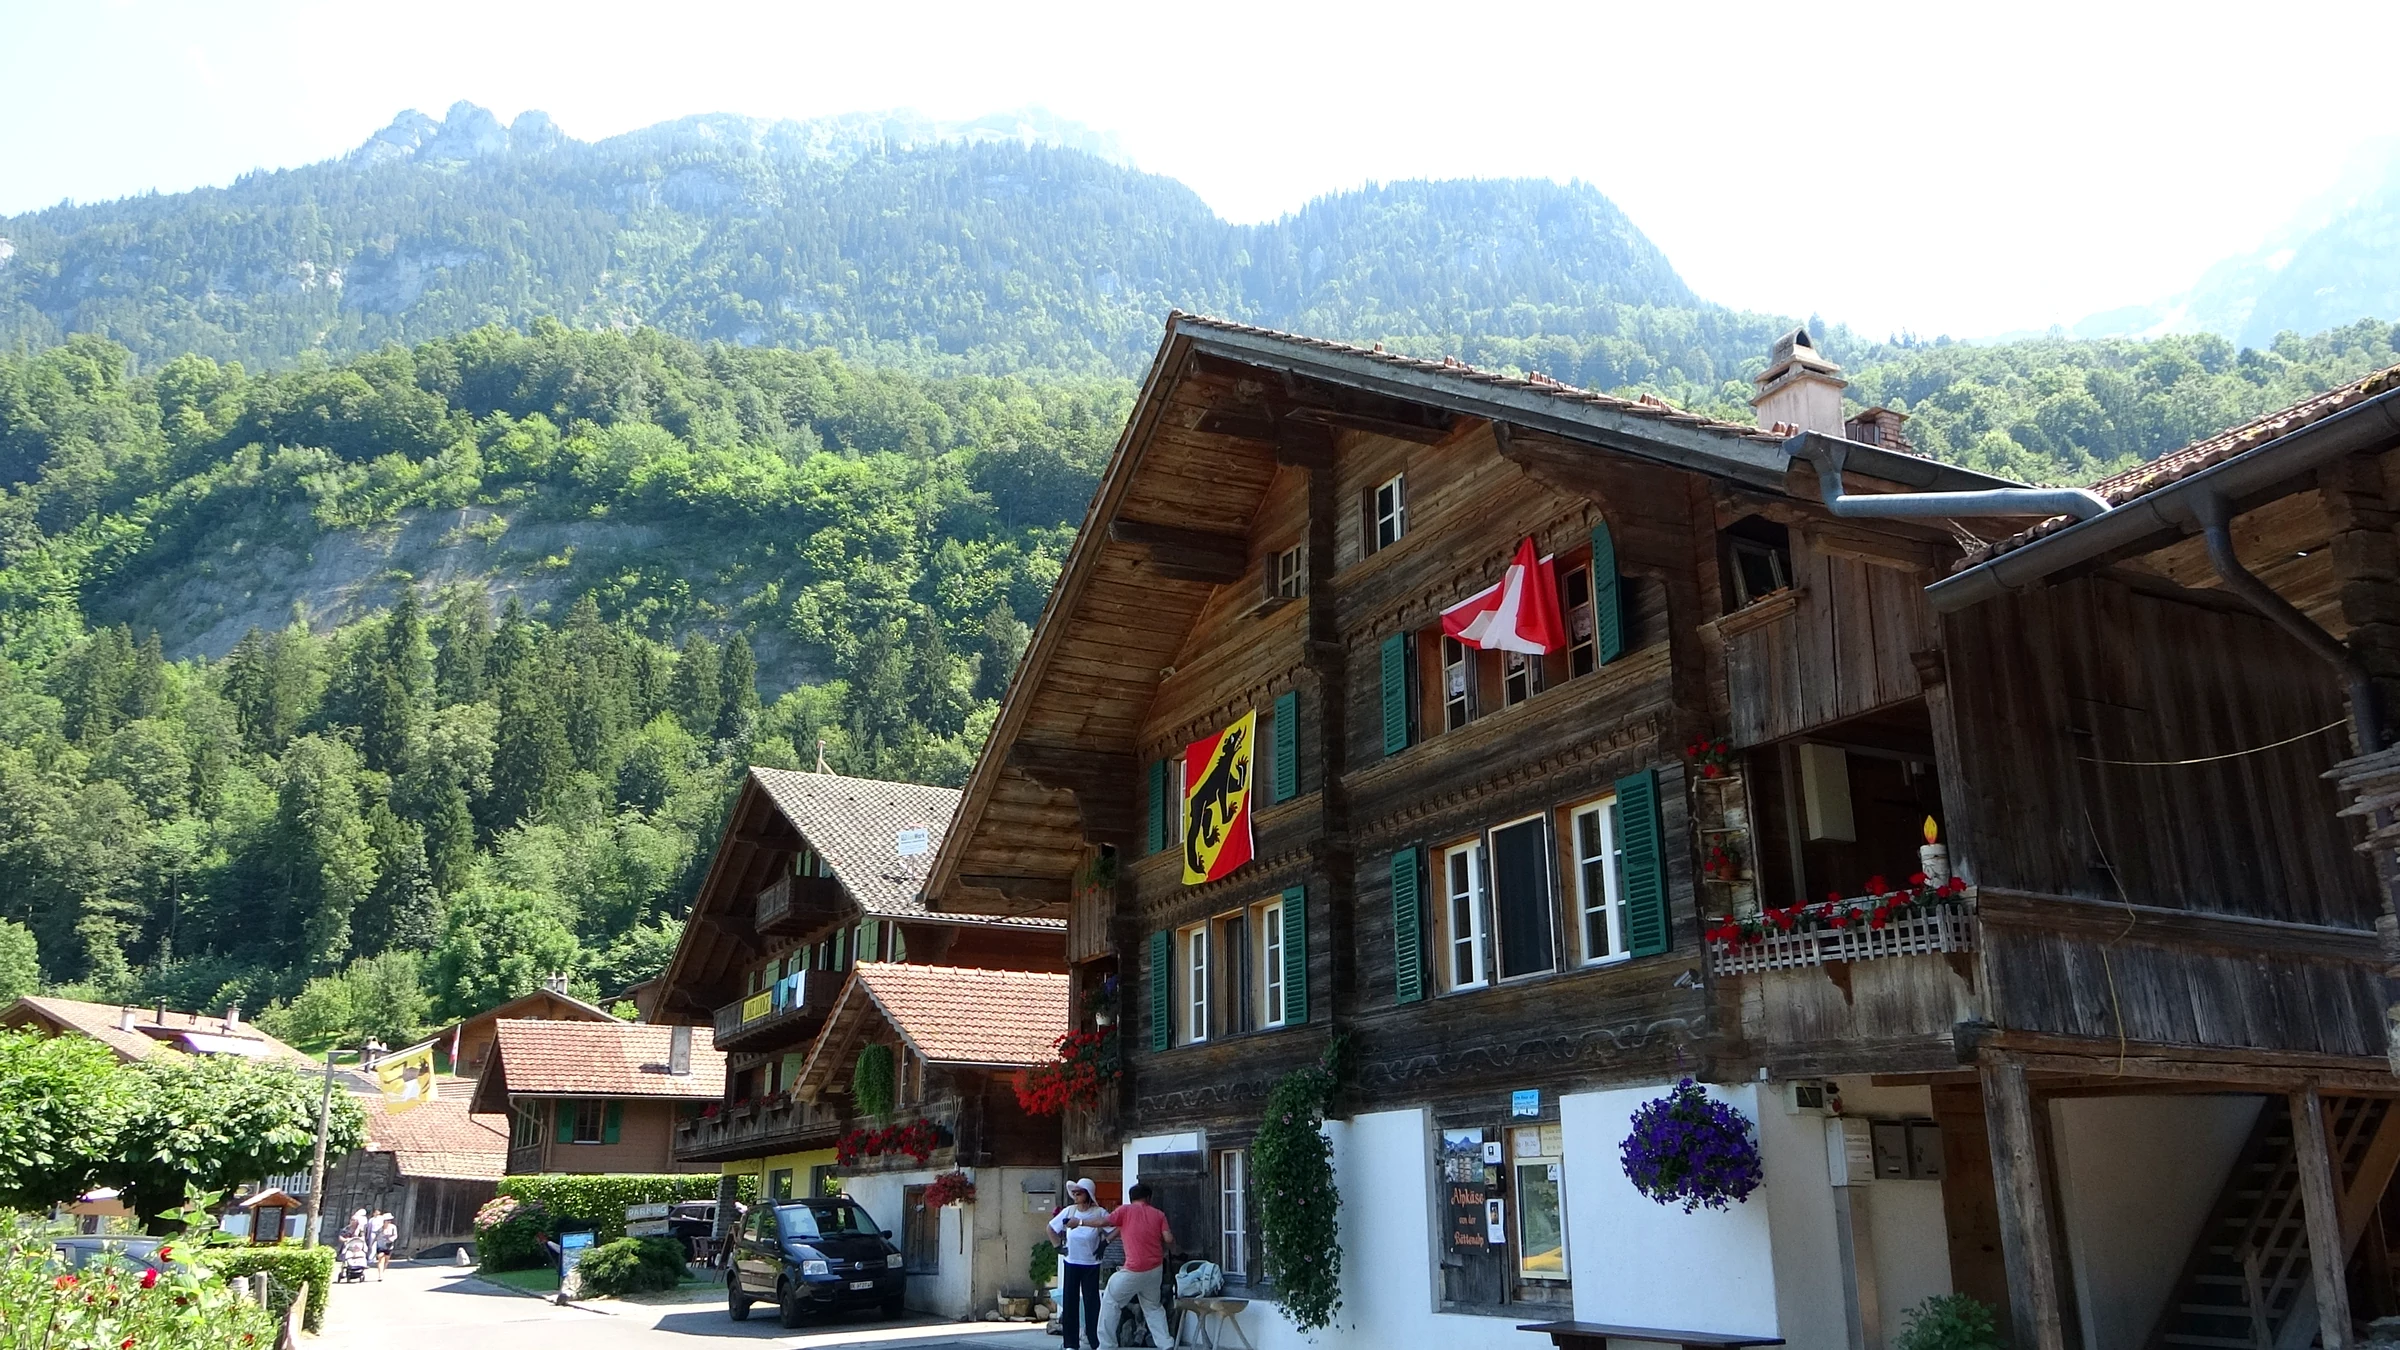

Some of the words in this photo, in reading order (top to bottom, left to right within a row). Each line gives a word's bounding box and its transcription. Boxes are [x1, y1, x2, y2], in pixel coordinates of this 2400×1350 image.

[1450, 1187, 1485, 1208] Alpkäse
[628, 1204, 667, 1217] PARKING
[1458, 1216, 1468, 1225] von
[1468, 1213, 1477, 1225] der
